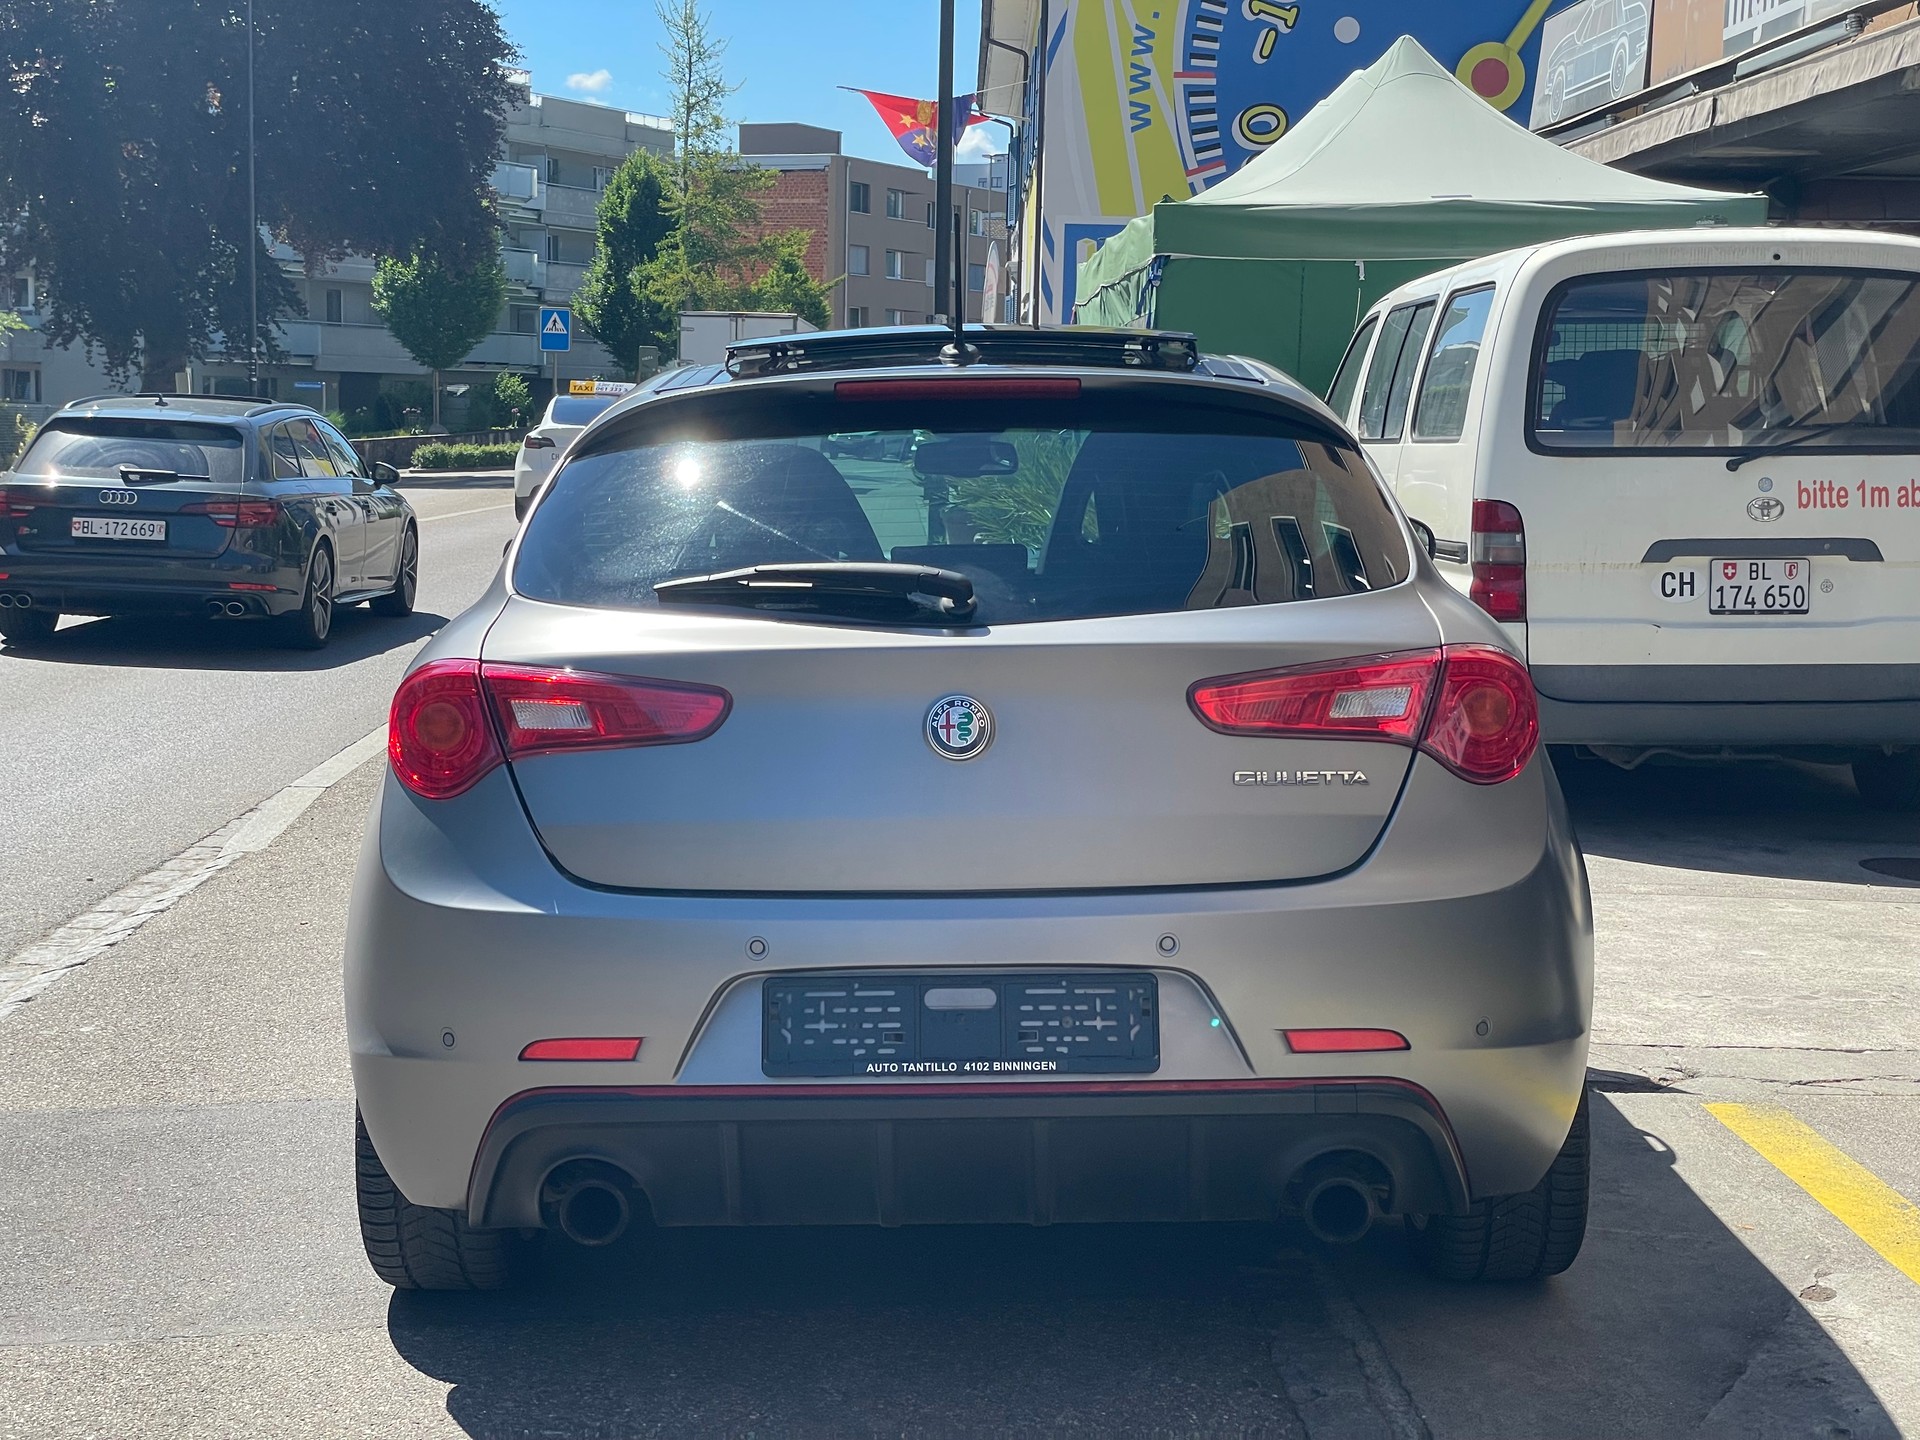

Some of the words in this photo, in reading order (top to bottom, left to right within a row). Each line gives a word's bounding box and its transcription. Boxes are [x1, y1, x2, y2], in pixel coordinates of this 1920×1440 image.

[551, 453, 560, 461] CH
[1797, 480, 1849, 509] bitte
[1856, 479, 1890, 508] 1m
[1749, 562, 1772, 581] BL
[1660, 571, 1696, 598] CH
[931, 703, 951, 728] ALFA
[954, 700, 986, 728] ROMEO
[1232, 770, 1370, 786] GIULIETTA
[866, 1062, 899, 1073] AUTO
[901, 1062, 957, 1072] TANTILLO
[963, 1062, 990, 1072] 4102
[993, 1061, 1057, 1072] BINNINGEN
